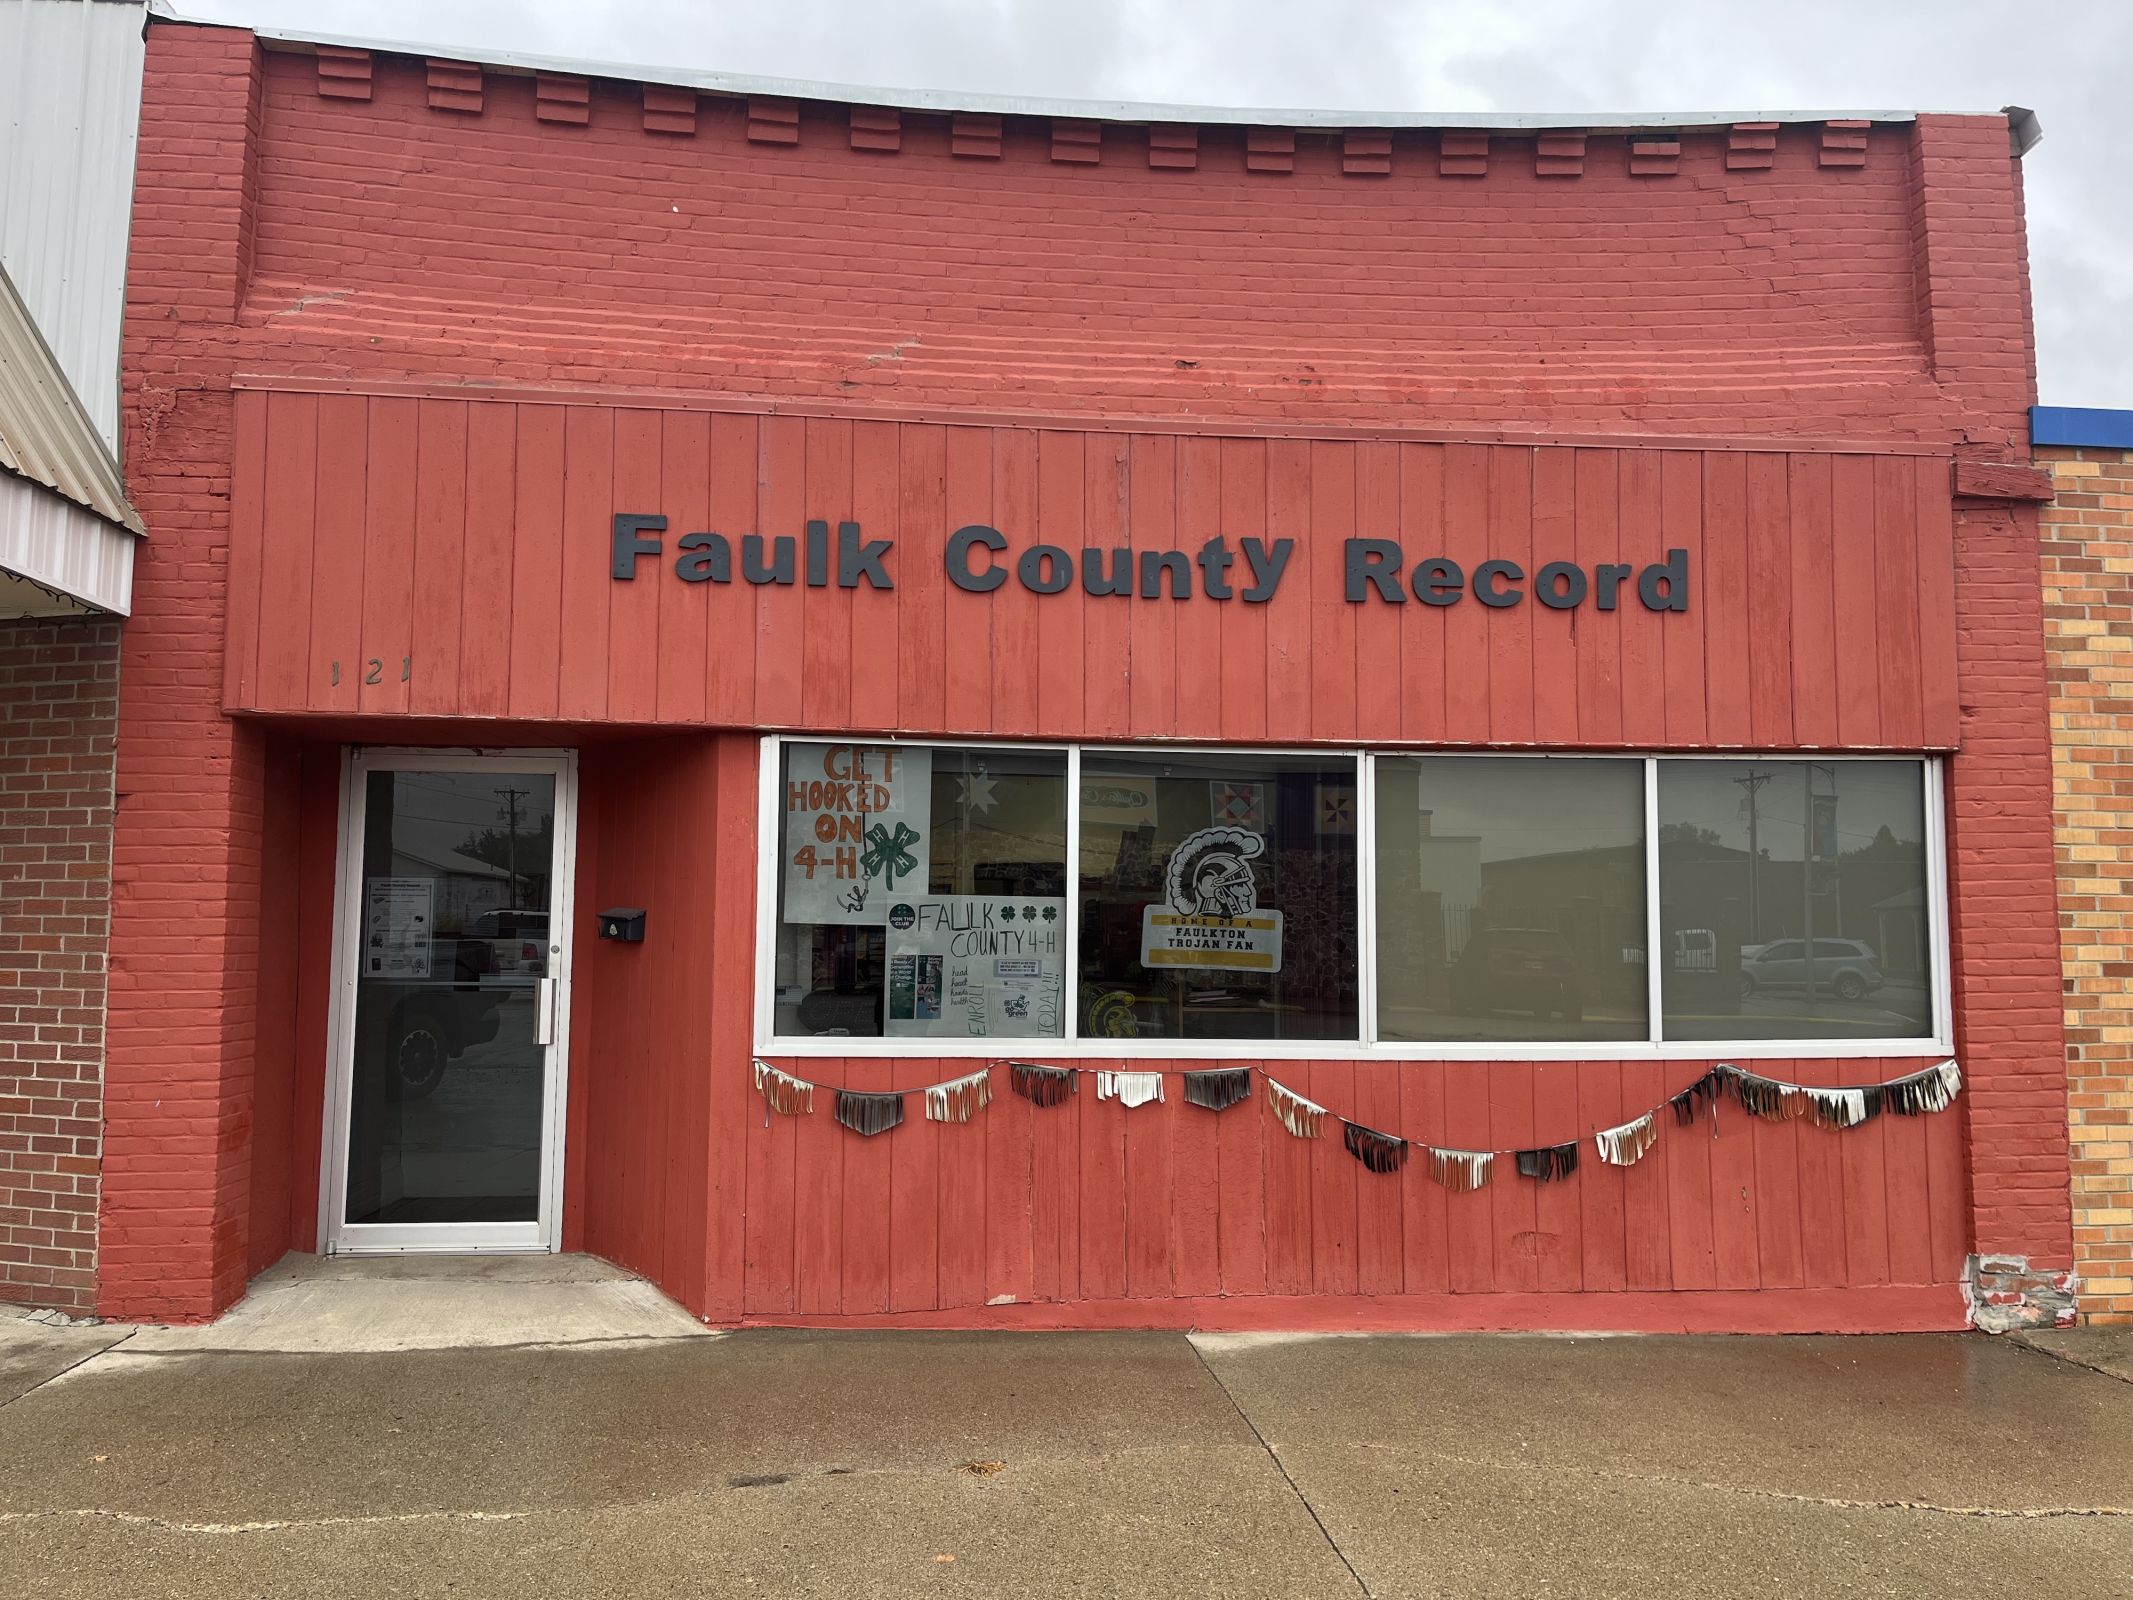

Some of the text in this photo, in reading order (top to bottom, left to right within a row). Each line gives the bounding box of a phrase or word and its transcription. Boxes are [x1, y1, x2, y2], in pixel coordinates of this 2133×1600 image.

[613, 513, 1688, 611] Faulk County Record
[824, 745, 903, 782] GET
[789, 781, 890, 813] HOOKED
[815, 814, 862, 843] ON
[872, 829, 910, 844] H H
[794, 845, 857, 880] 4-H
[868, 852, 910, 868] H H
[918, 902, 994, 932] FAULK
[1171, 917, 1207, 925] HOME
[951, 930, 1055, 958] COUNTY 4-H
[1168, 939, 1253, 950] TROJAN FAN
[1176, 927, 1246, 939] FAULKTON
[952, 965, 968, 976] head
[968, 980, 986, 1036] ENROLL
